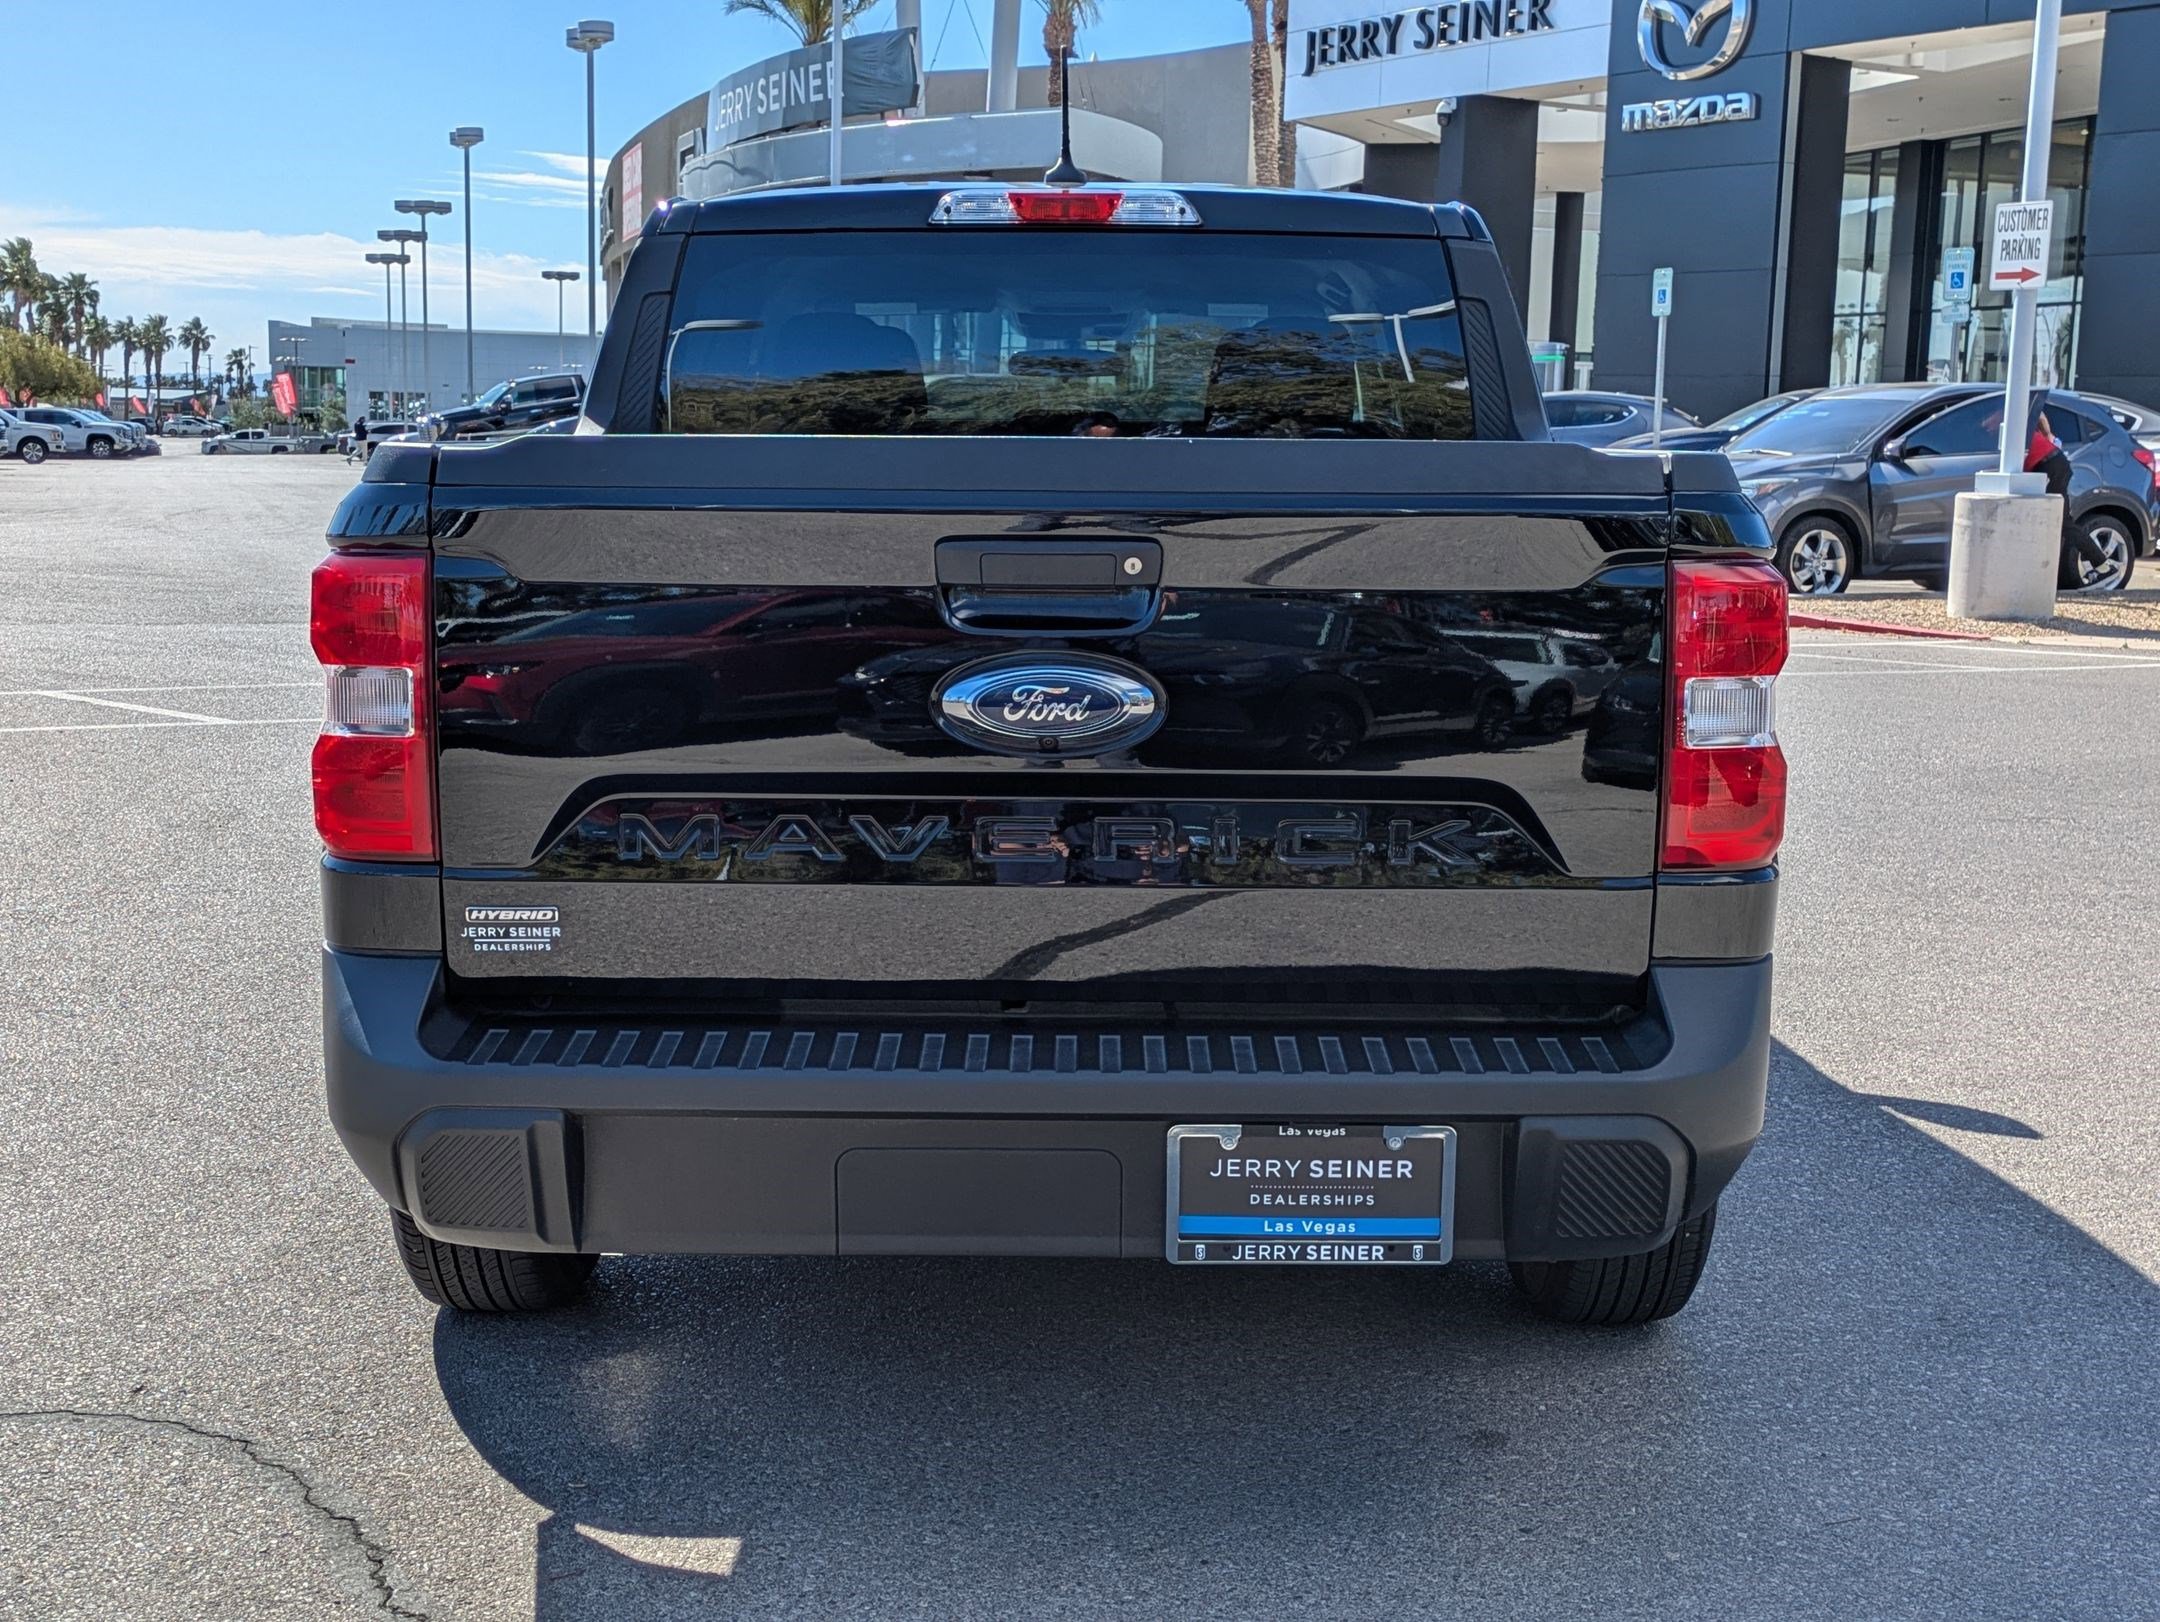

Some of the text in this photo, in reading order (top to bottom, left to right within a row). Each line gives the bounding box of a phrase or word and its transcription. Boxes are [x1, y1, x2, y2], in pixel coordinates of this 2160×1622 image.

[1301, 0, 1555, 77] JERRY SEINER
[714, 82, 753, 132] JERRY
[1621, 91, 1758, 132] mazda
[1997, 207, 2049, 233] CUSTOMER
[2000, 237, 2041, 261] PARKING
[1003, 684, 1092, 722] Ford
[618, 812, 1480, 866] MAVERICK
[470, 910, 554, 920] HYBRID
[461, 927, 561, 937] JERRY SEINER
[474, 943, 552, 951] DEALERSHIPS
[1279, 1126, 1301, 1136] Las
[1210, 1159, 1413, 1179] JERRY SEINER
[1250, 1194, 1375, 1206] DEALERSHIPS
[1264, 1221, 1356, 1235] Las Vegas
[1232, 1245, 1384, 1261] JERRY SEINER
